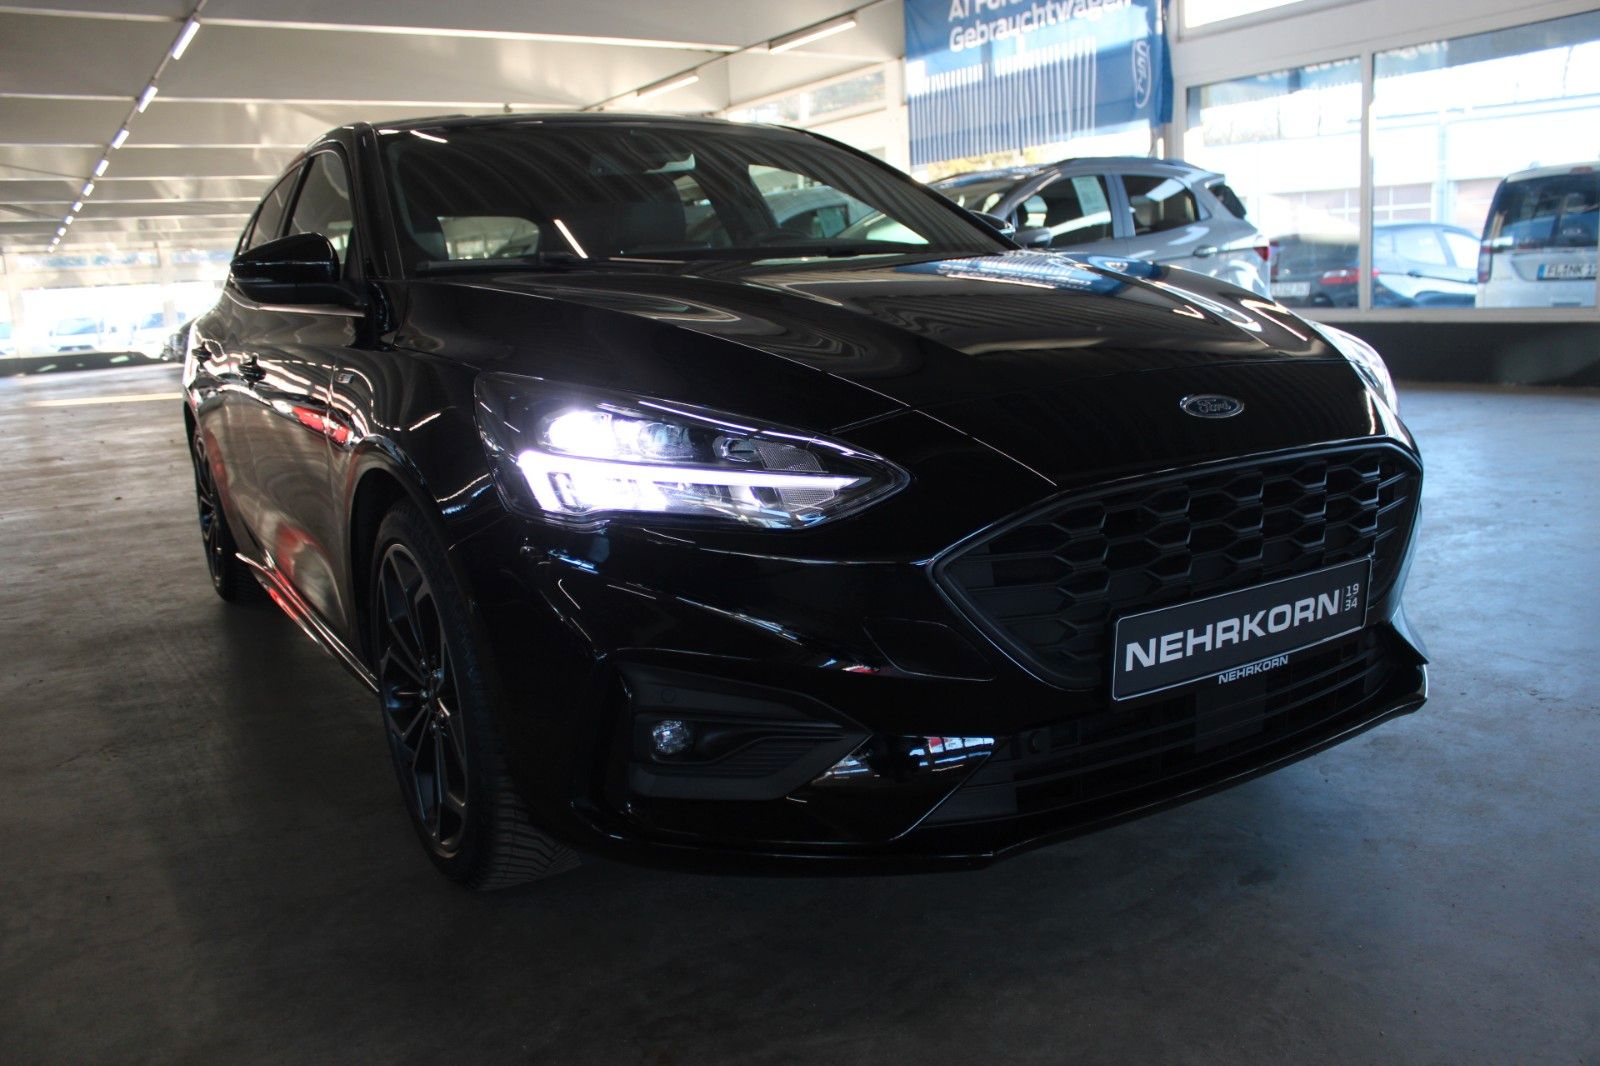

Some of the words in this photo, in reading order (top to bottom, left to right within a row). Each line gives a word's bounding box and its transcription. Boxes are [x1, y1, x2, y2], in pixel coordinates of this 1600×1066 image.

[1346, 583, 1359, 597] 19
[1345, 597, 1358, 611] 34
[1125, 589, 1340, 672] NEHRKORN
[1218, 655, 1289, 684] NEHRKORN
